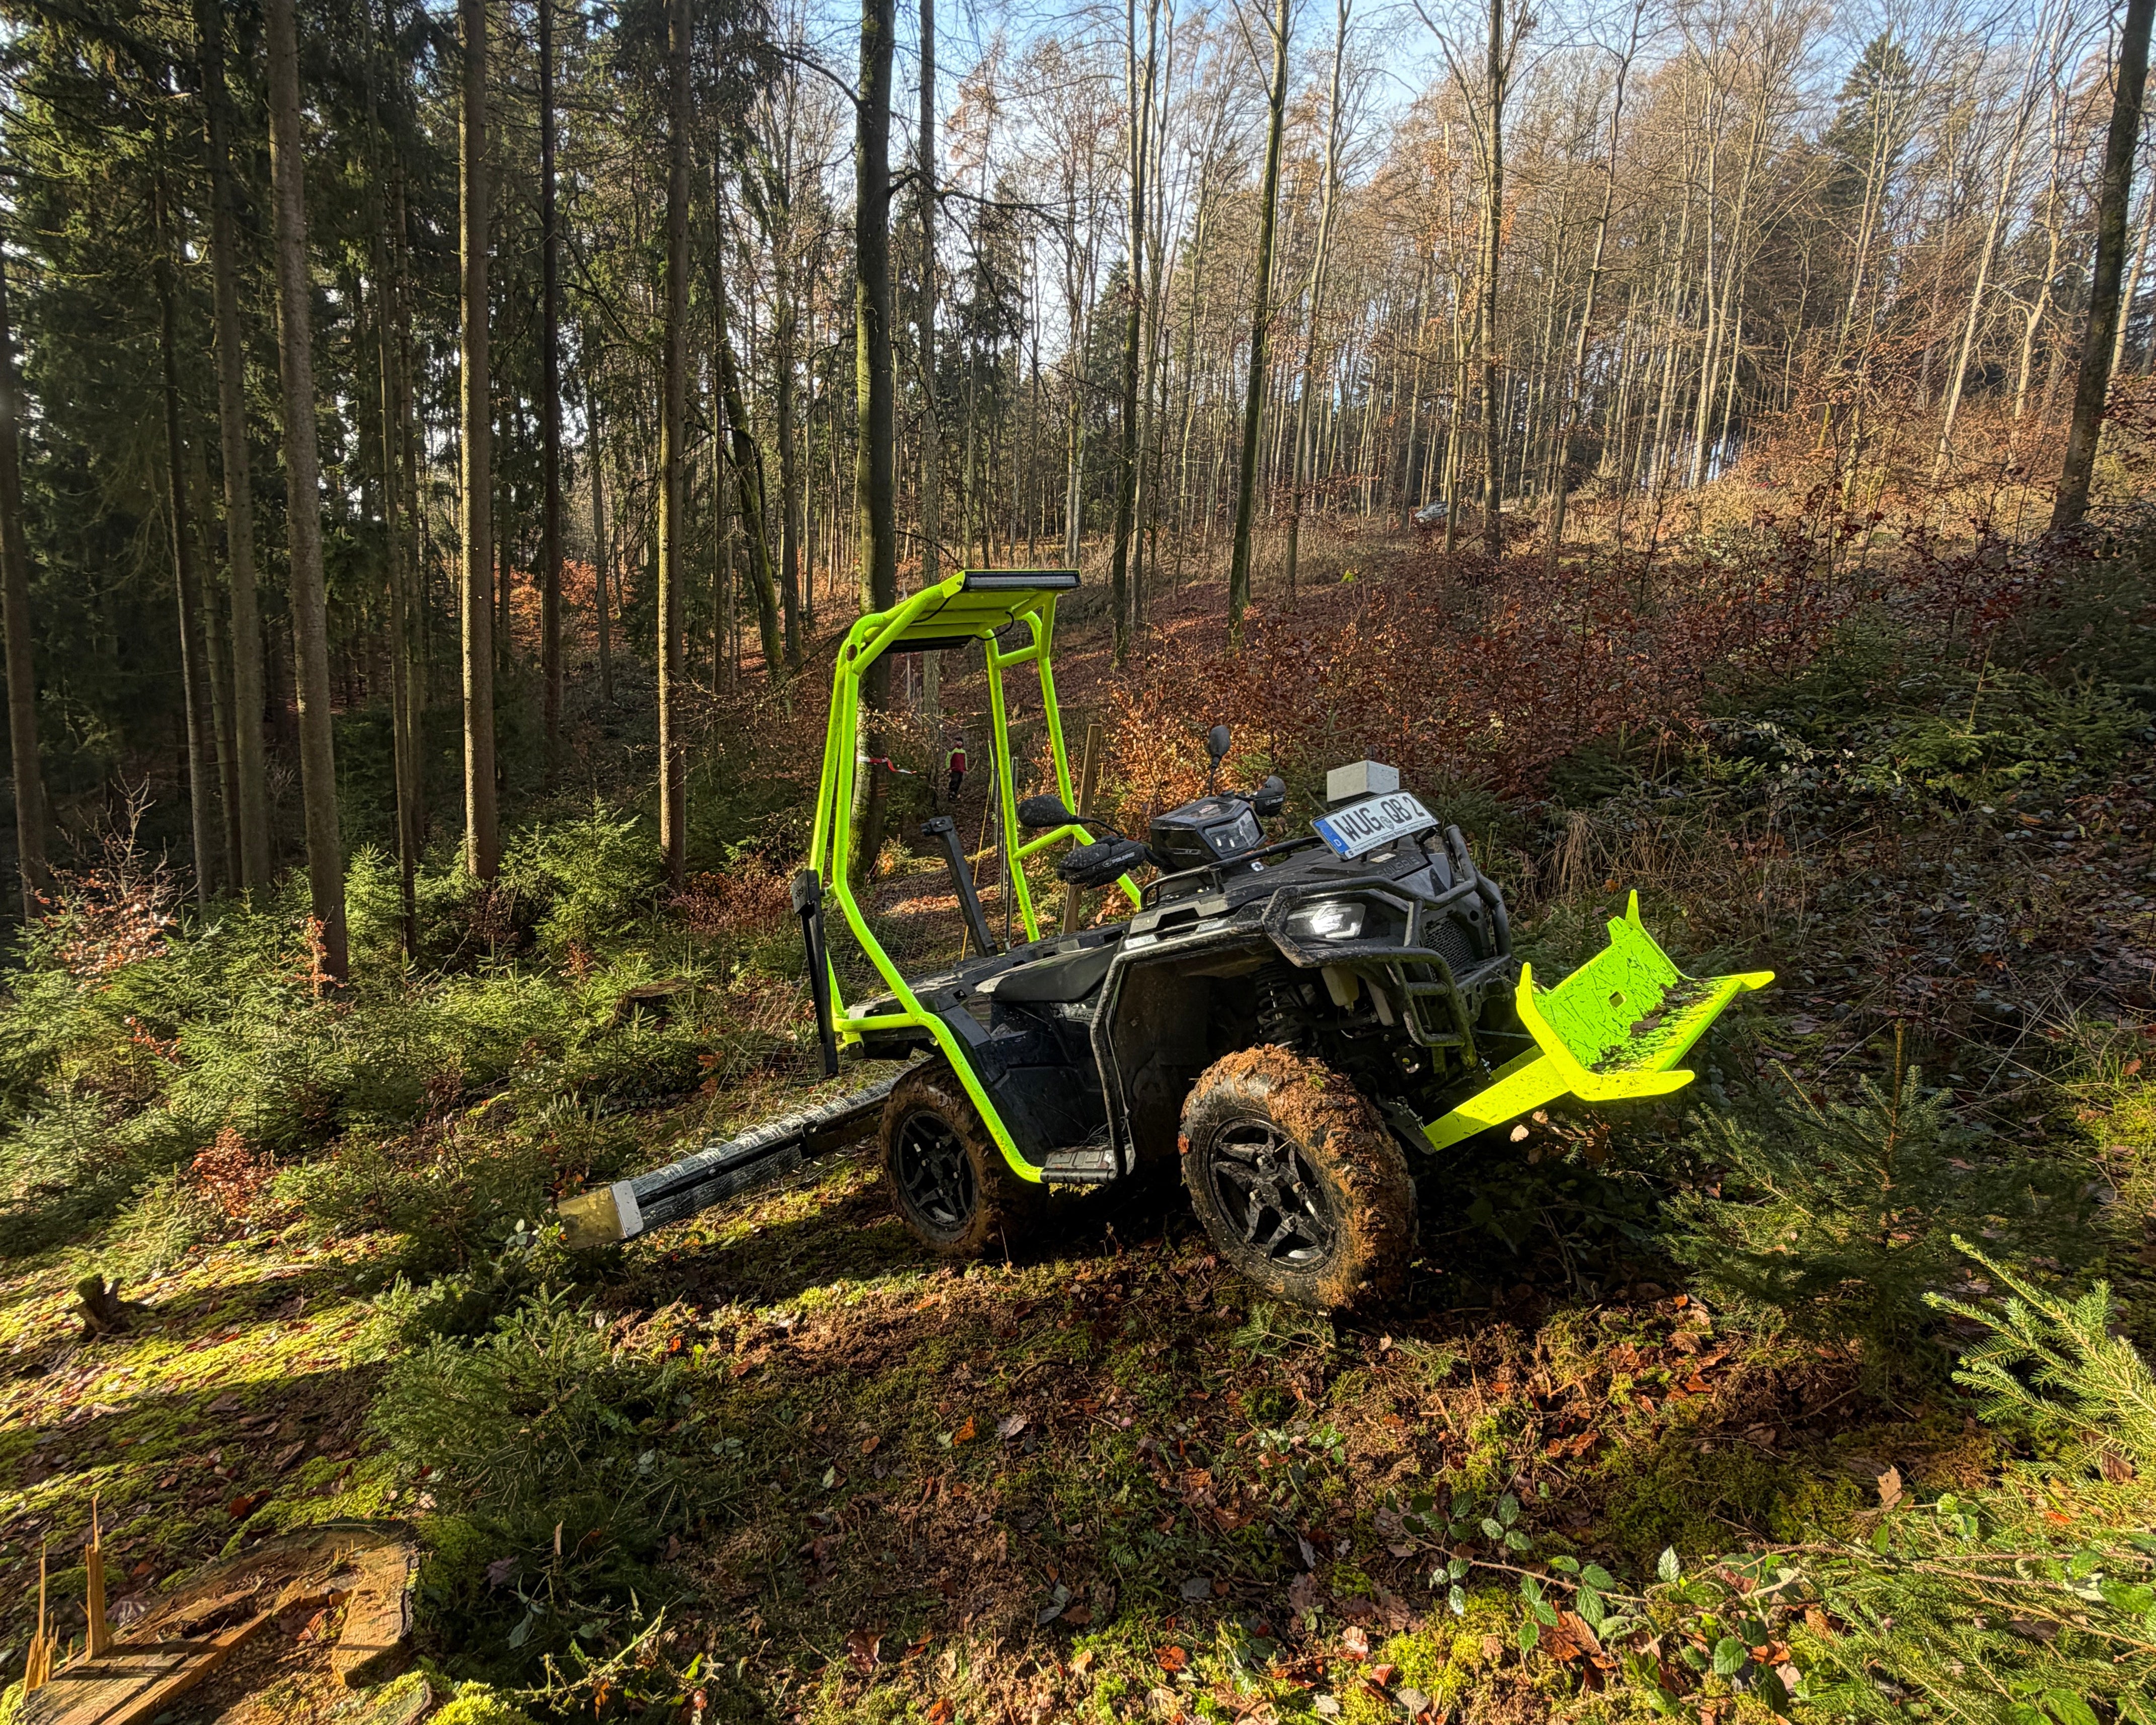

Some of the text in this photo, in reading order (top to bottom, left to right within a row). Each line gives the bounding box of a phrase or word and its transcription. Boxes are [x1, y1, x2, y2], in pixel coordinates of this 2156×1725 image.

[1333, 807, 1385, 842] WUG
[1380, 799, 1413, 824] QB
[1402, 796, 1425, 817] 2
[1334, 839, 1342, 847] D
